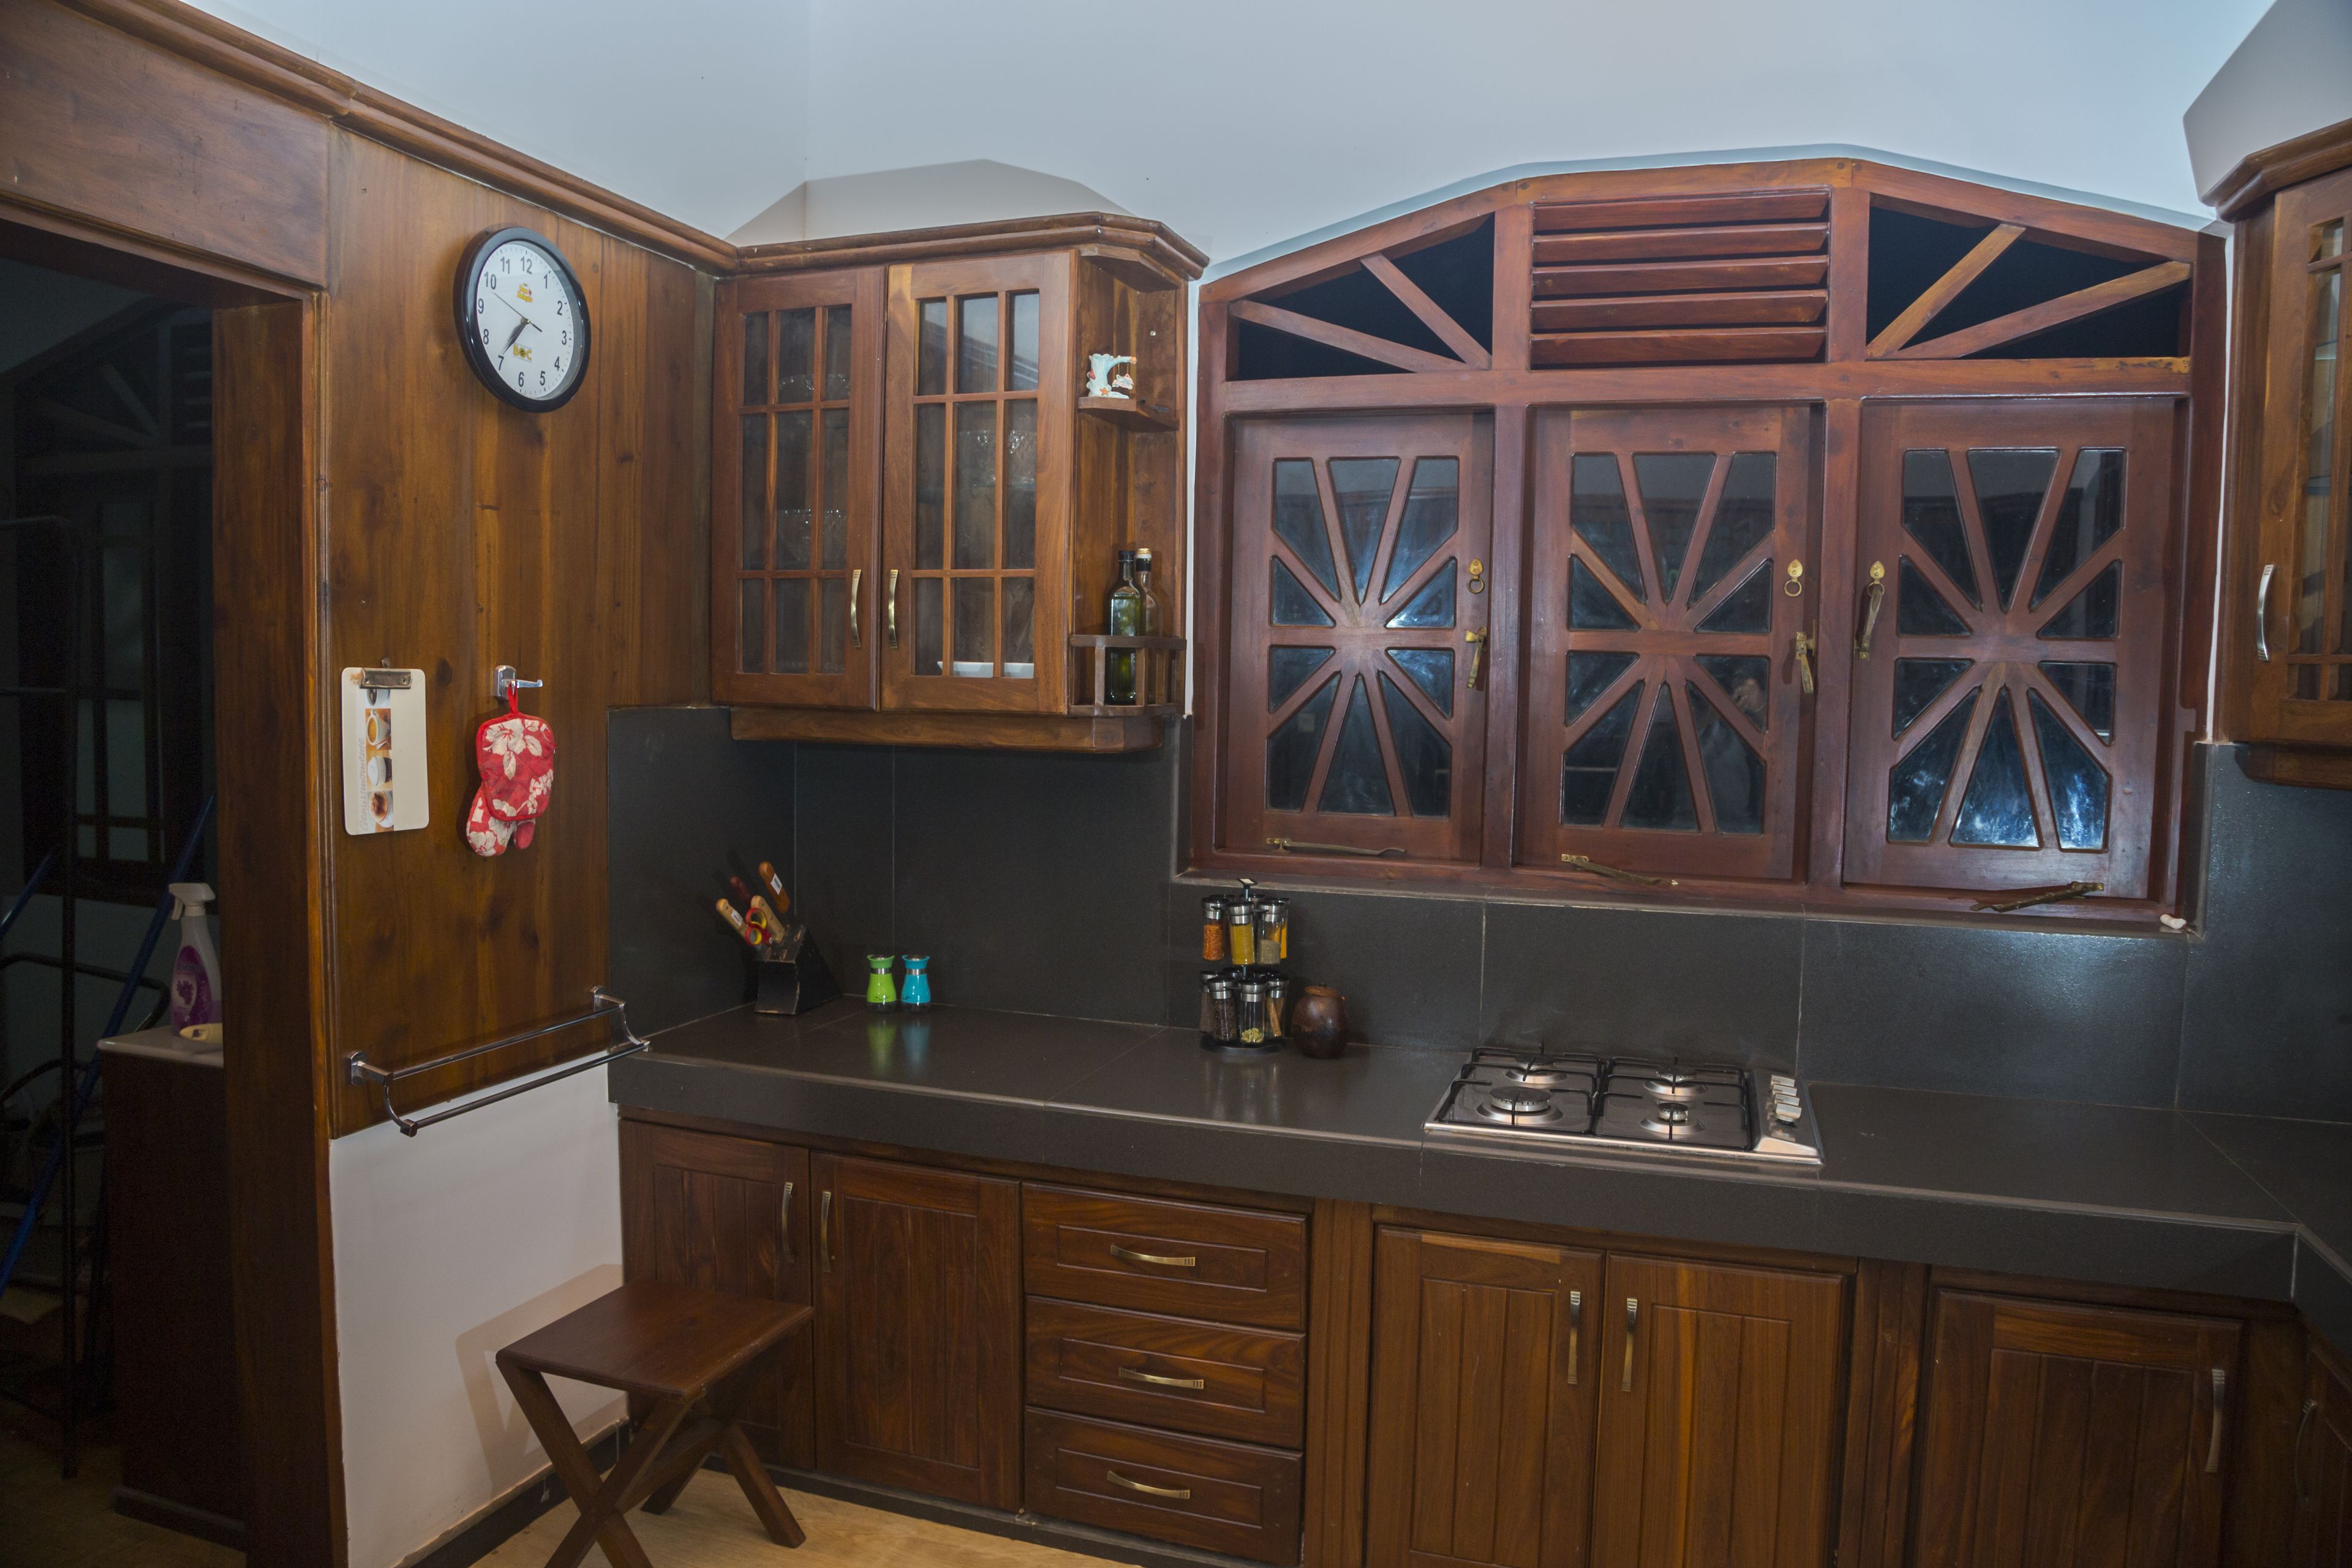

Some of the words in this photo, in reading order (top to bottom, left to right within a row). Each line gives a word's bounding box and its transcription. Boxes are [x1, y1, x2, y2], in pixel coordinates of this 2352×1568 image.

[500, 257, 510, 274] 11
[521, 257, 532, 274] 12
[484, 271, 496, 290] 10
[543, 274, 548, 288] 1
[478, 298, 484, 314] 9
[557, 301, 563, 315] 2
[483, 329, 489, 345] 8
[561, 330, 567, 345] 3
[513, 344, 532, 361] BOC
[498, 355, 504, 371] 7
[554, 356, 560, 371] 4
[518, 371, 524, 387] 6
[540, 371, 545, 386] 5
